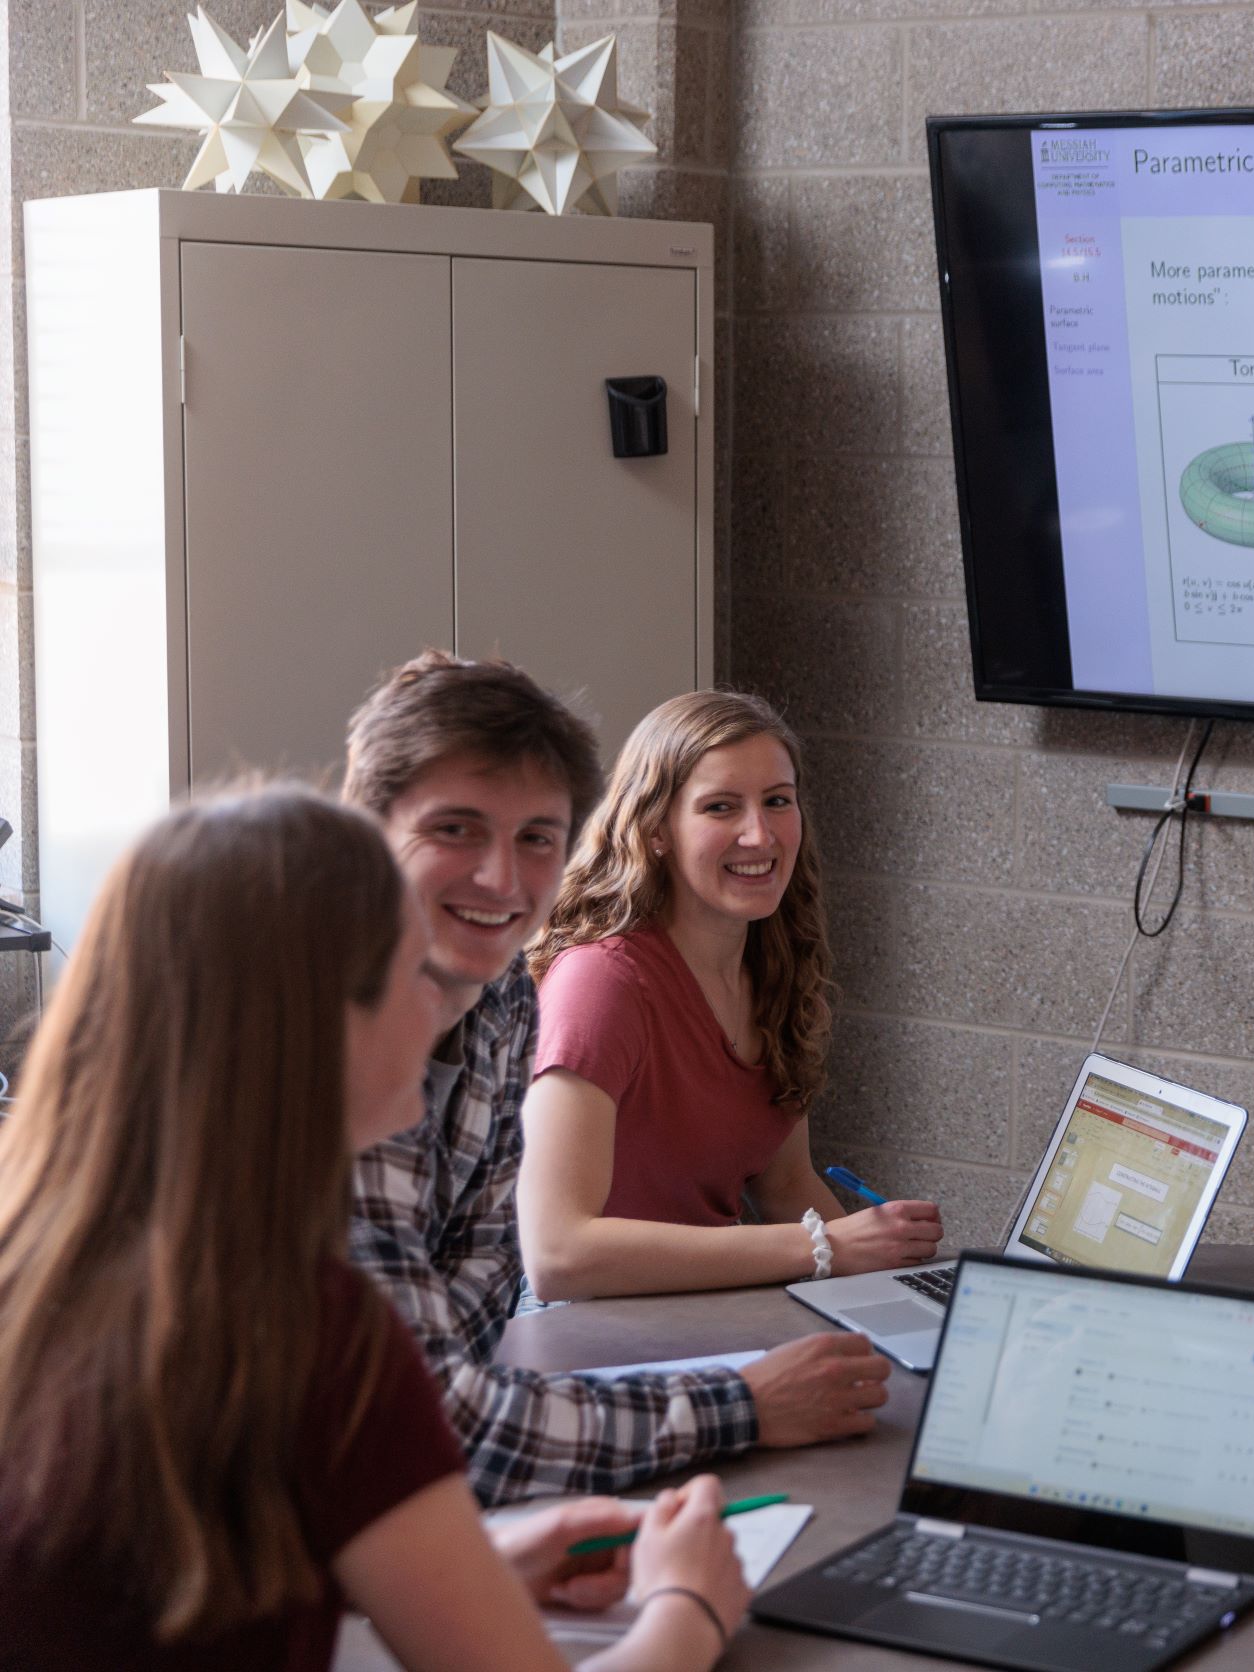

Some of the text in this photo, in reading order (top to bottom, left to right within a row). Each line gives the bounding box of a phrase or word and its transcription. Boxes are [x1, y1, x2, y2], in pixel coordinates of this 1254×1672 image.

[1051, 139, 1096, 150] MESSIAH
[1134, 148, 1254, 174] Parametric
[1151, 262, 1191, 278] More
[1050, 304, 1094, 316] Parametric
[1050, 318, 1079, 328] surface
